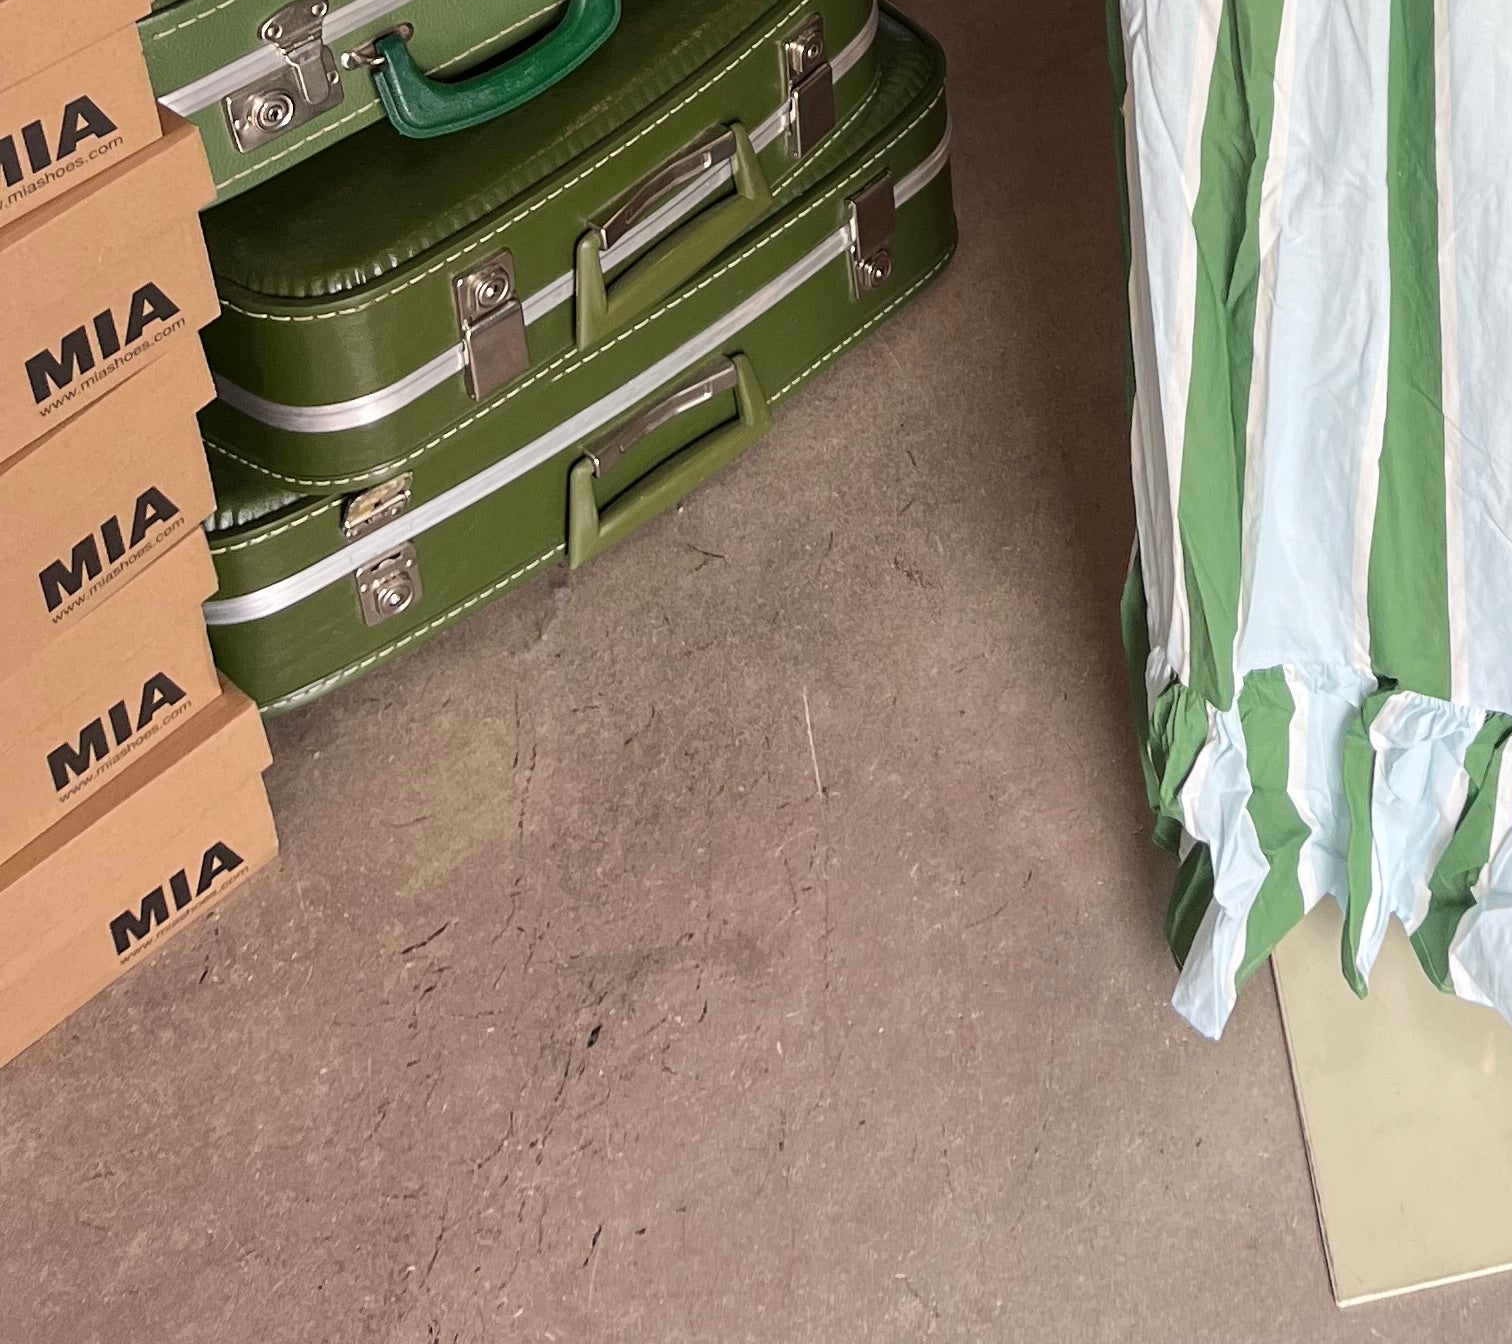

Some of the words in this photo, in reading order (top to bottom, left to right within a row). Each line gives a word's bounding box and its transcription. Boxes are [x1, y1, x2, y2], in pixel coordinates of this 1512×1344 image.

[0, 135, 124, 211] .miashoes.com
[24, 281, 181, 405] MIA
[39, 316, 186, 418] www.miashoes.com
[38, 485, 180, 613] MIA
[51, 515, 185, 625] www.miashoes.com
[46, 671, 187, 792] MIA
[57, 699, 192, 803] www.miashoes.com
[109, 840, 245, 956] MIA
